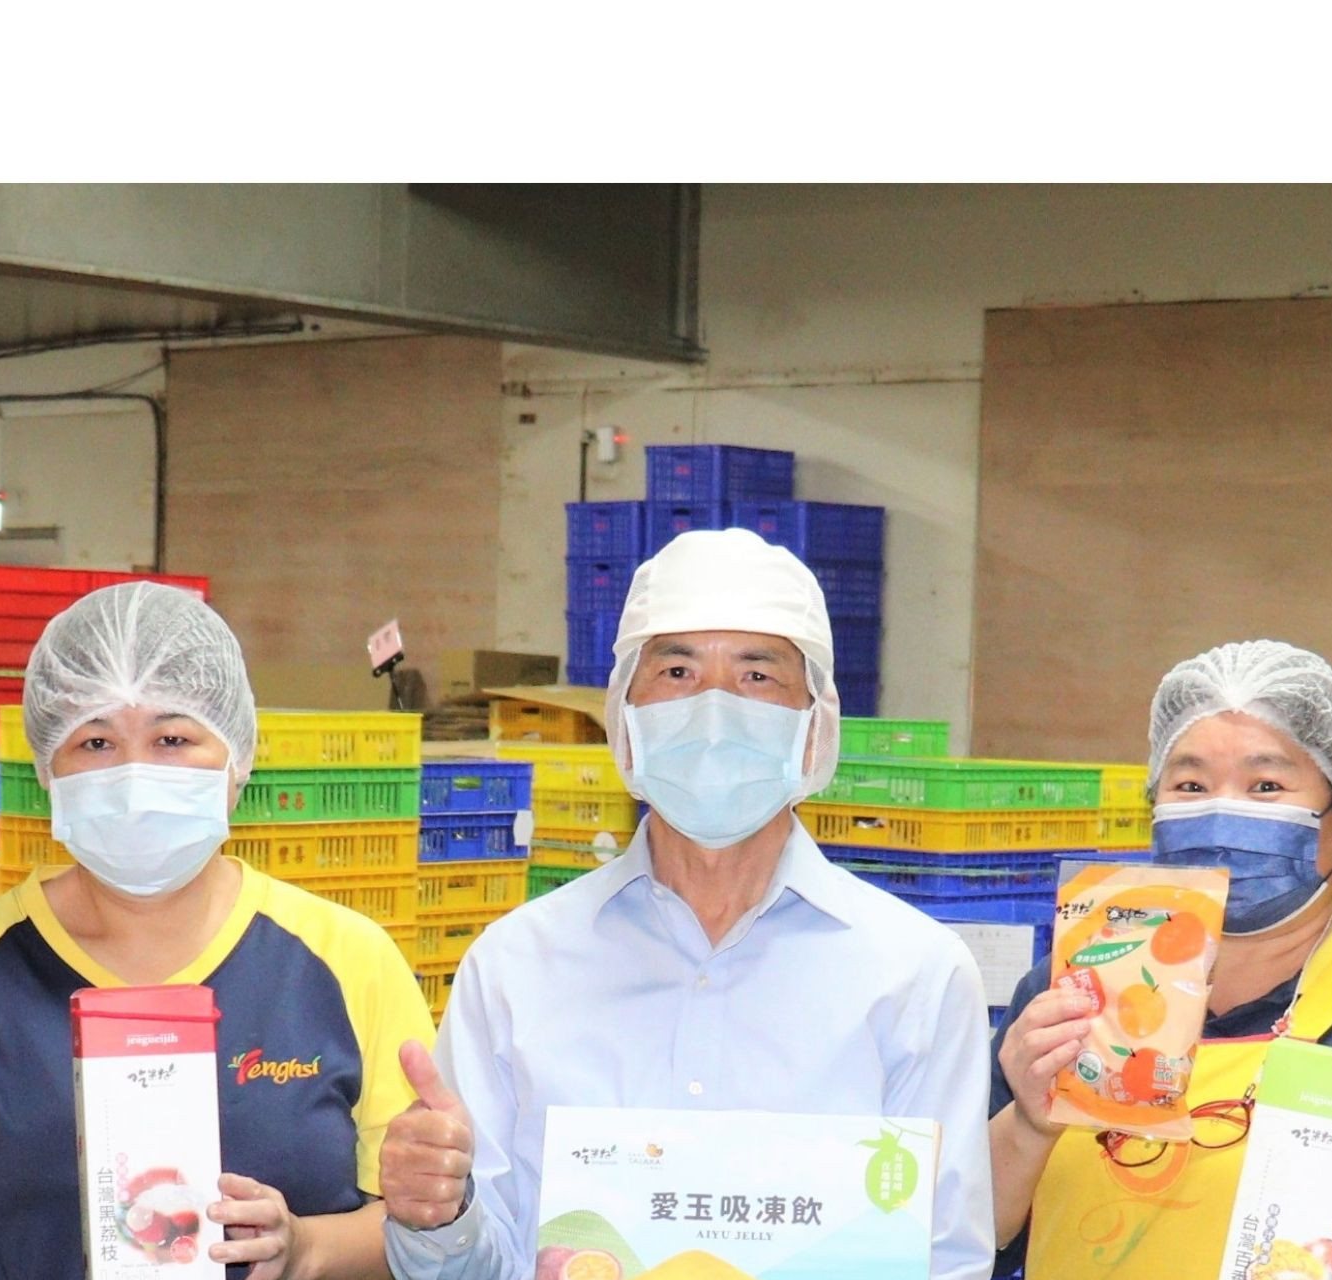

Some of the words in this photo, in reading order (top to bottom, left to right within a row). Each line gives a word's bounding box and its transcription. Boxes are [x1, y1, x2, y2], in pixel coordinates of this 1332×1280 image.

[228, 1048, 321, 1084] Fenghsi
[97, 1166, 119, 1262] 台灣黑荔枝
[650, 1191, 823, 1226] 愛玉吸凍飲
[696, 1230, 731, 1241] AIYU
[735, 1231, 774, 1242] JELLY
